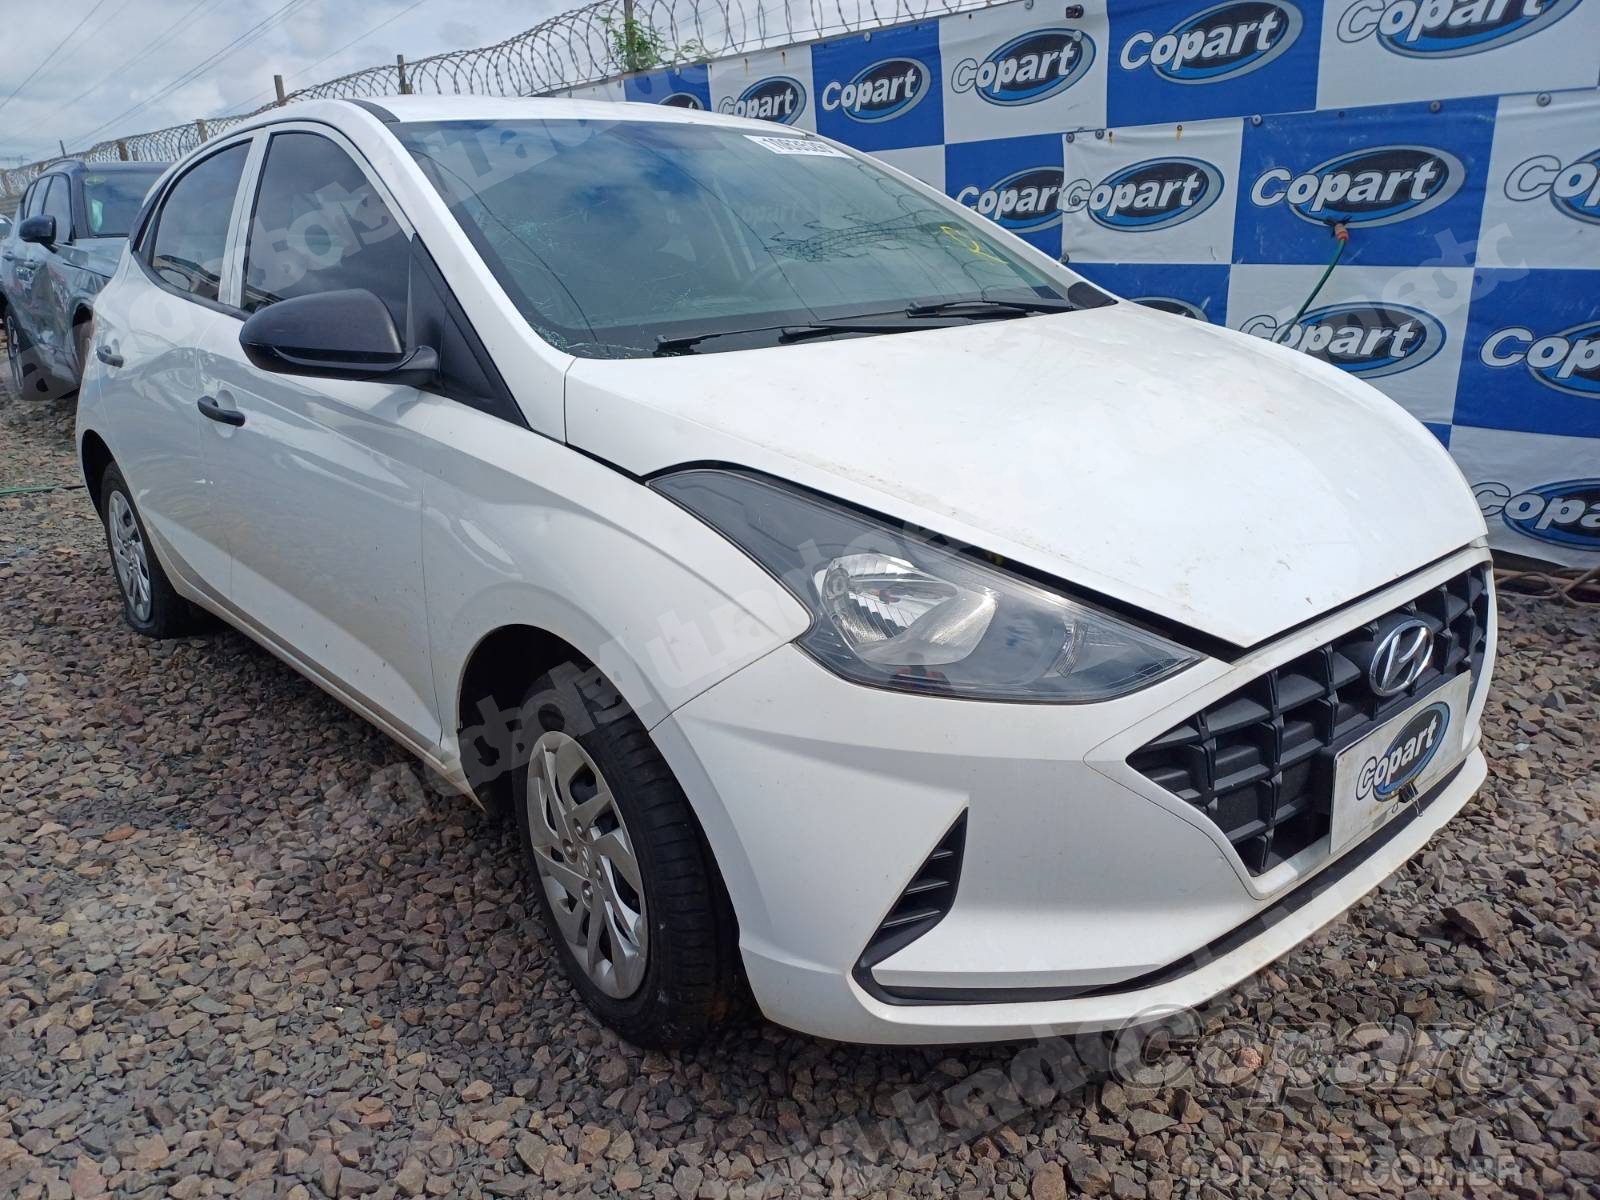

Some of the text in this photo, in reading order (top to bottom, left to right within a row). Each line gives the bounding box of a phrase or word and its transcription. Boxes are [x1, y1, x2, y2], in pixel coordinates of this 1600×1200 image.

[950, 38, 1075, 95] Copart
[1118, 9, 1279, 74] Copart
[821, 68, 917, 112] Copart
[1061, 170, 1202, 217] Copart
[1250, 160, 1439, 213] Copart
[1355, 714, 1438, 801] Copart
